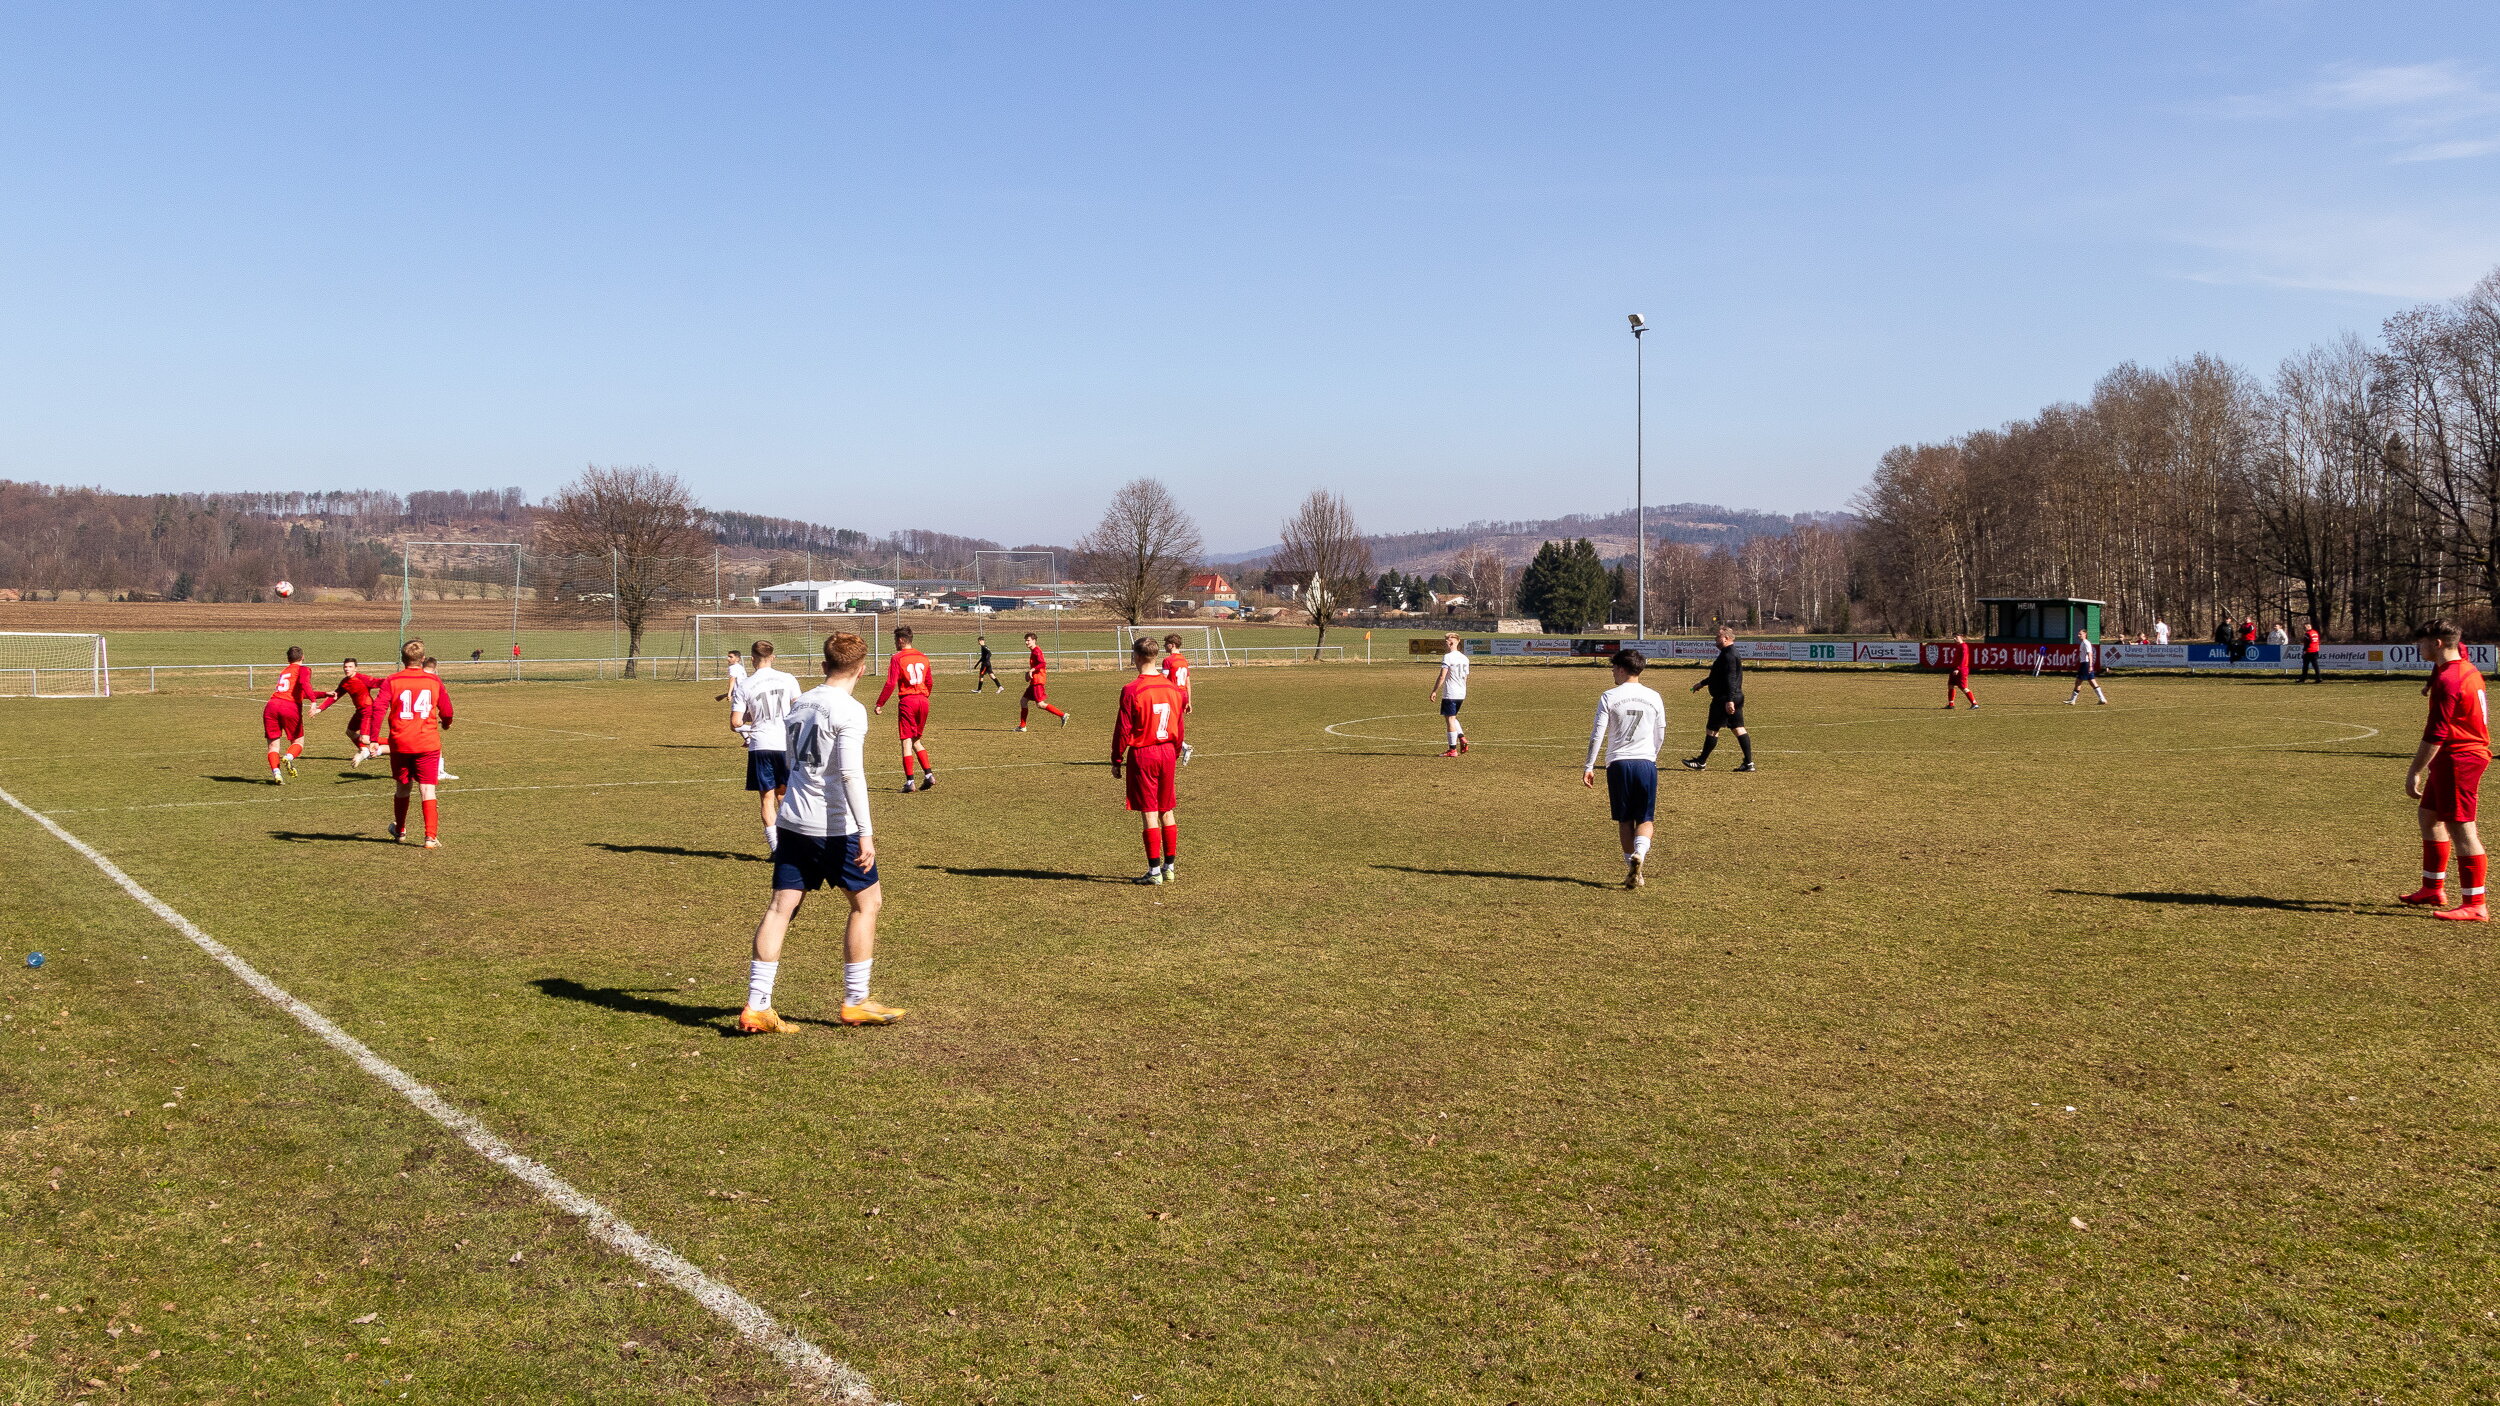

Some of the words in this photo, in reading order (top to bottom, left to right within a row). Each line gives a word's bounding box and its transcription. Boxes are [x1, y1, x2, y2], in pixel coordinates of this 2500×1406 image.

[1755, 643, 1785, 651] Bäckerei
[1810, 645, 1835, 658] BTB
[1858, 645, 1894, 659] Augst
[2147, 645, 2184, 653] Harnisch
[2328, 651, 2366, 661] Hohlfeld
[1974, 648, 2008, 665] 1859
[277, 673, 292, 692] 5
[399, 689, 433, 720] 14
[755, 688, 784, 720] 17
[1152, 702, 1171, 740] 7
[1625, 709, 1643, 742] 7
[788, 721, 824, 774] 14
